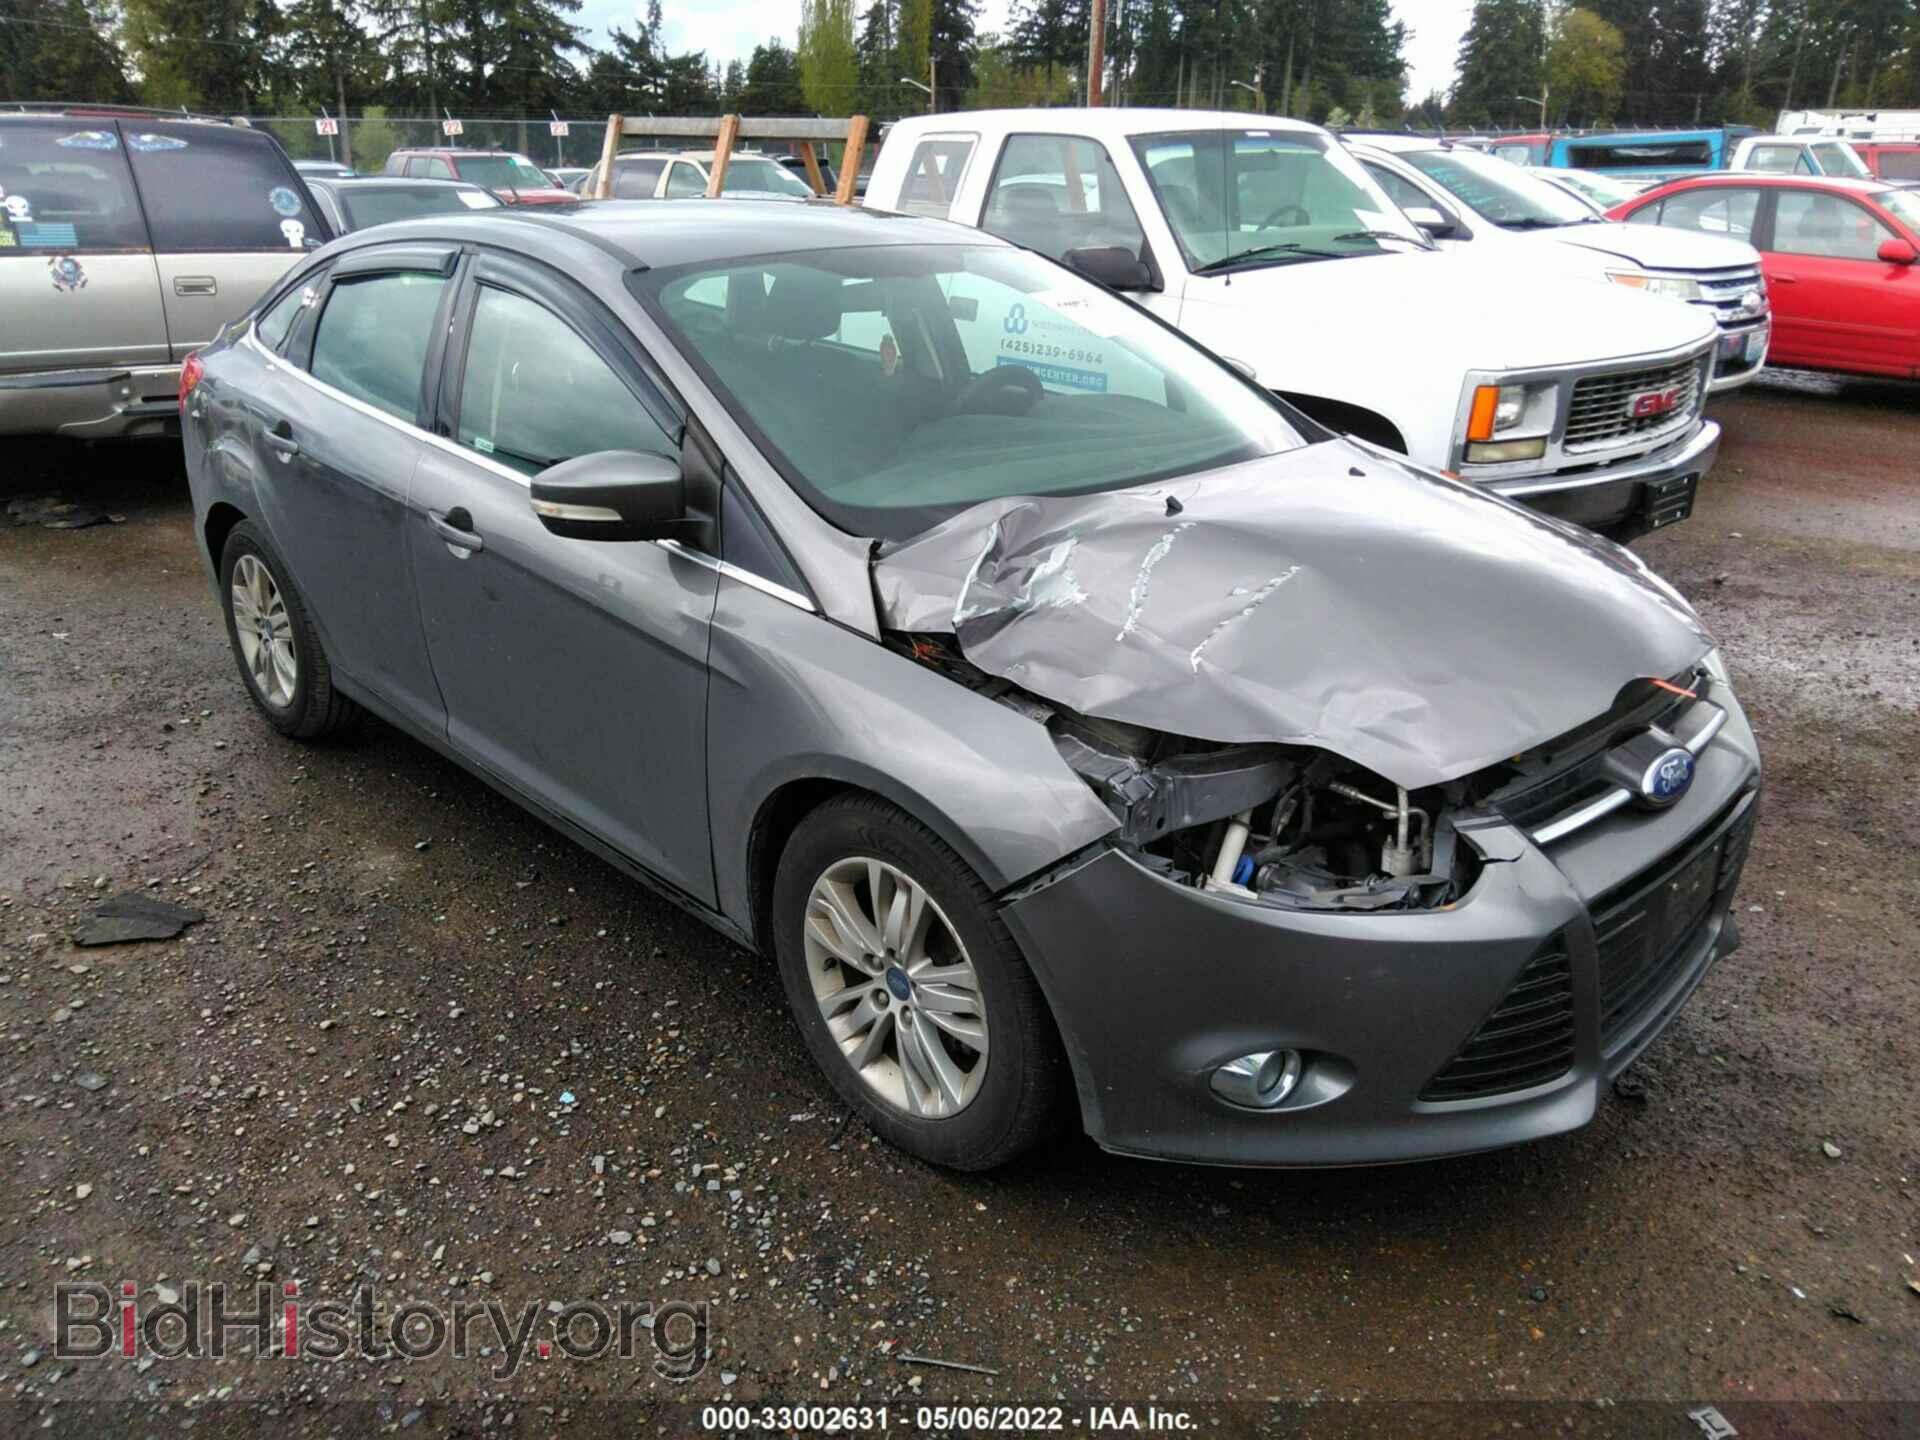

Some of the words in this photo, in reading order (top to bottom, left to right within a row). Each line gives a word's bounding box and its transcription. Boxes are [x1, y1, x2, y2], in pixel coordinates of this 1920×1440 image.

[321, 119, 334, 133] 21
[446, 120, 460, 134] 22
[1633, 387, 1681, 416] GMC
